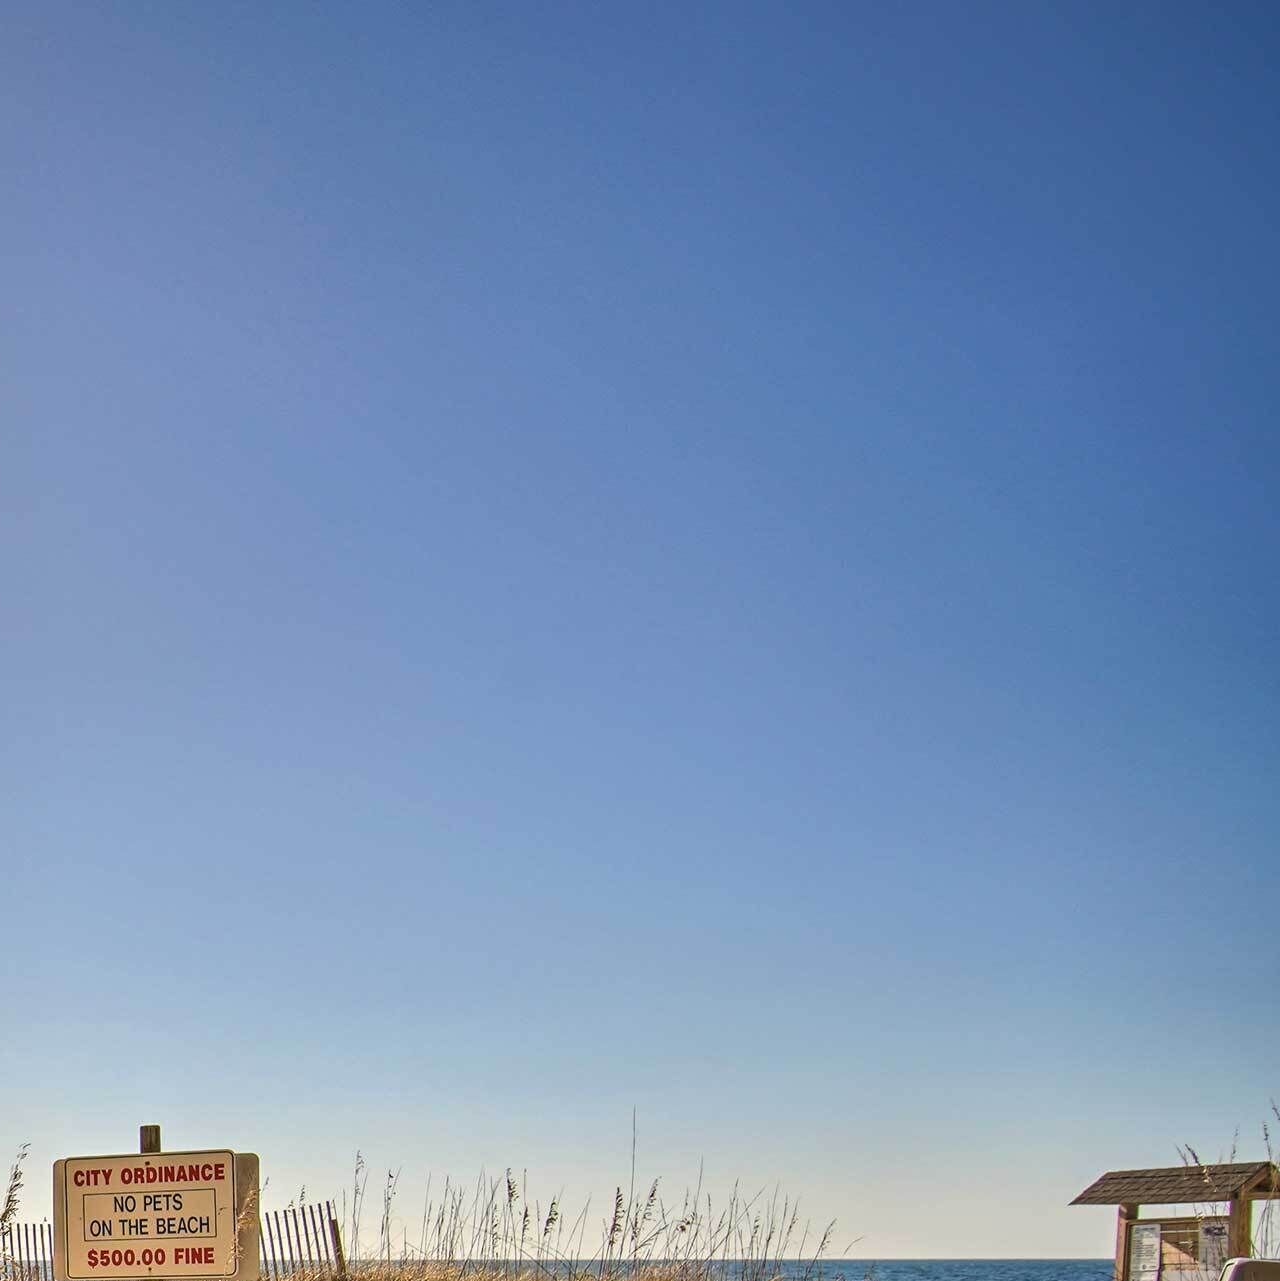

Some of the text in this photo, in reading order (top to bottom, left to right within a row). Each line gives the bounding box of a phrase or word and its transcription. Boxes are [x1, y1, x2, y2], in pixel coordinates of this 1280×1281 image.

[74, 1163, 225, 1187] CITY ORDINANCE
[113, 1193, 183, 1212] NO PETS
[90, 1216, 210, 1237] ON THE BEACH
[87, 1247, 215, 1269] $500.00 FINE
